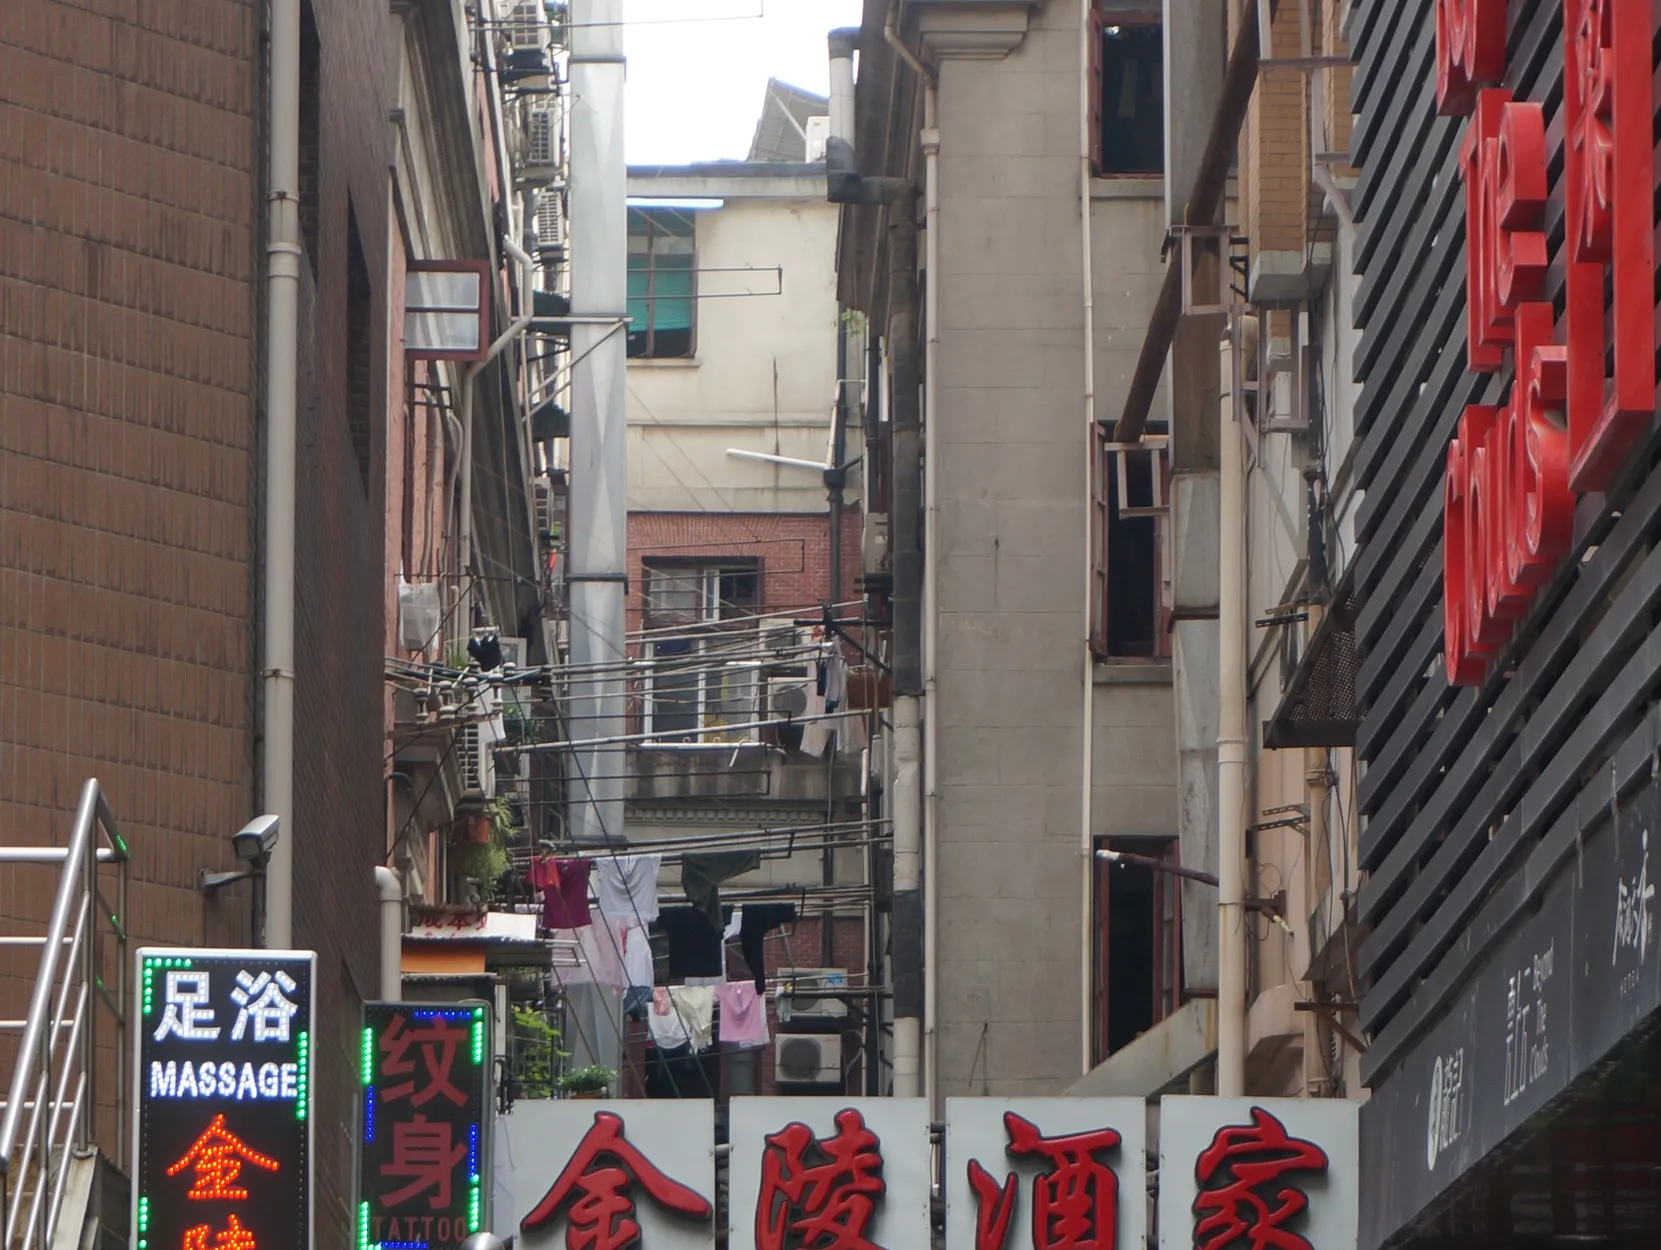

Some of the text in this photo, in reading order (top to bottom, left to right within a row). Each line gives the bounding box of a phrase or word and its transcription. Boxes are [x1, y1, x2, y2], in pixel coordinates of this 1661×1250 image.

[154, 969, 299, 1041] 足浴
[151, 1061, 297, 1099] MASSAGE
[379, 1013, 468, 1210] 纹身
[373, 1216, 467, 1242] TATTOO
